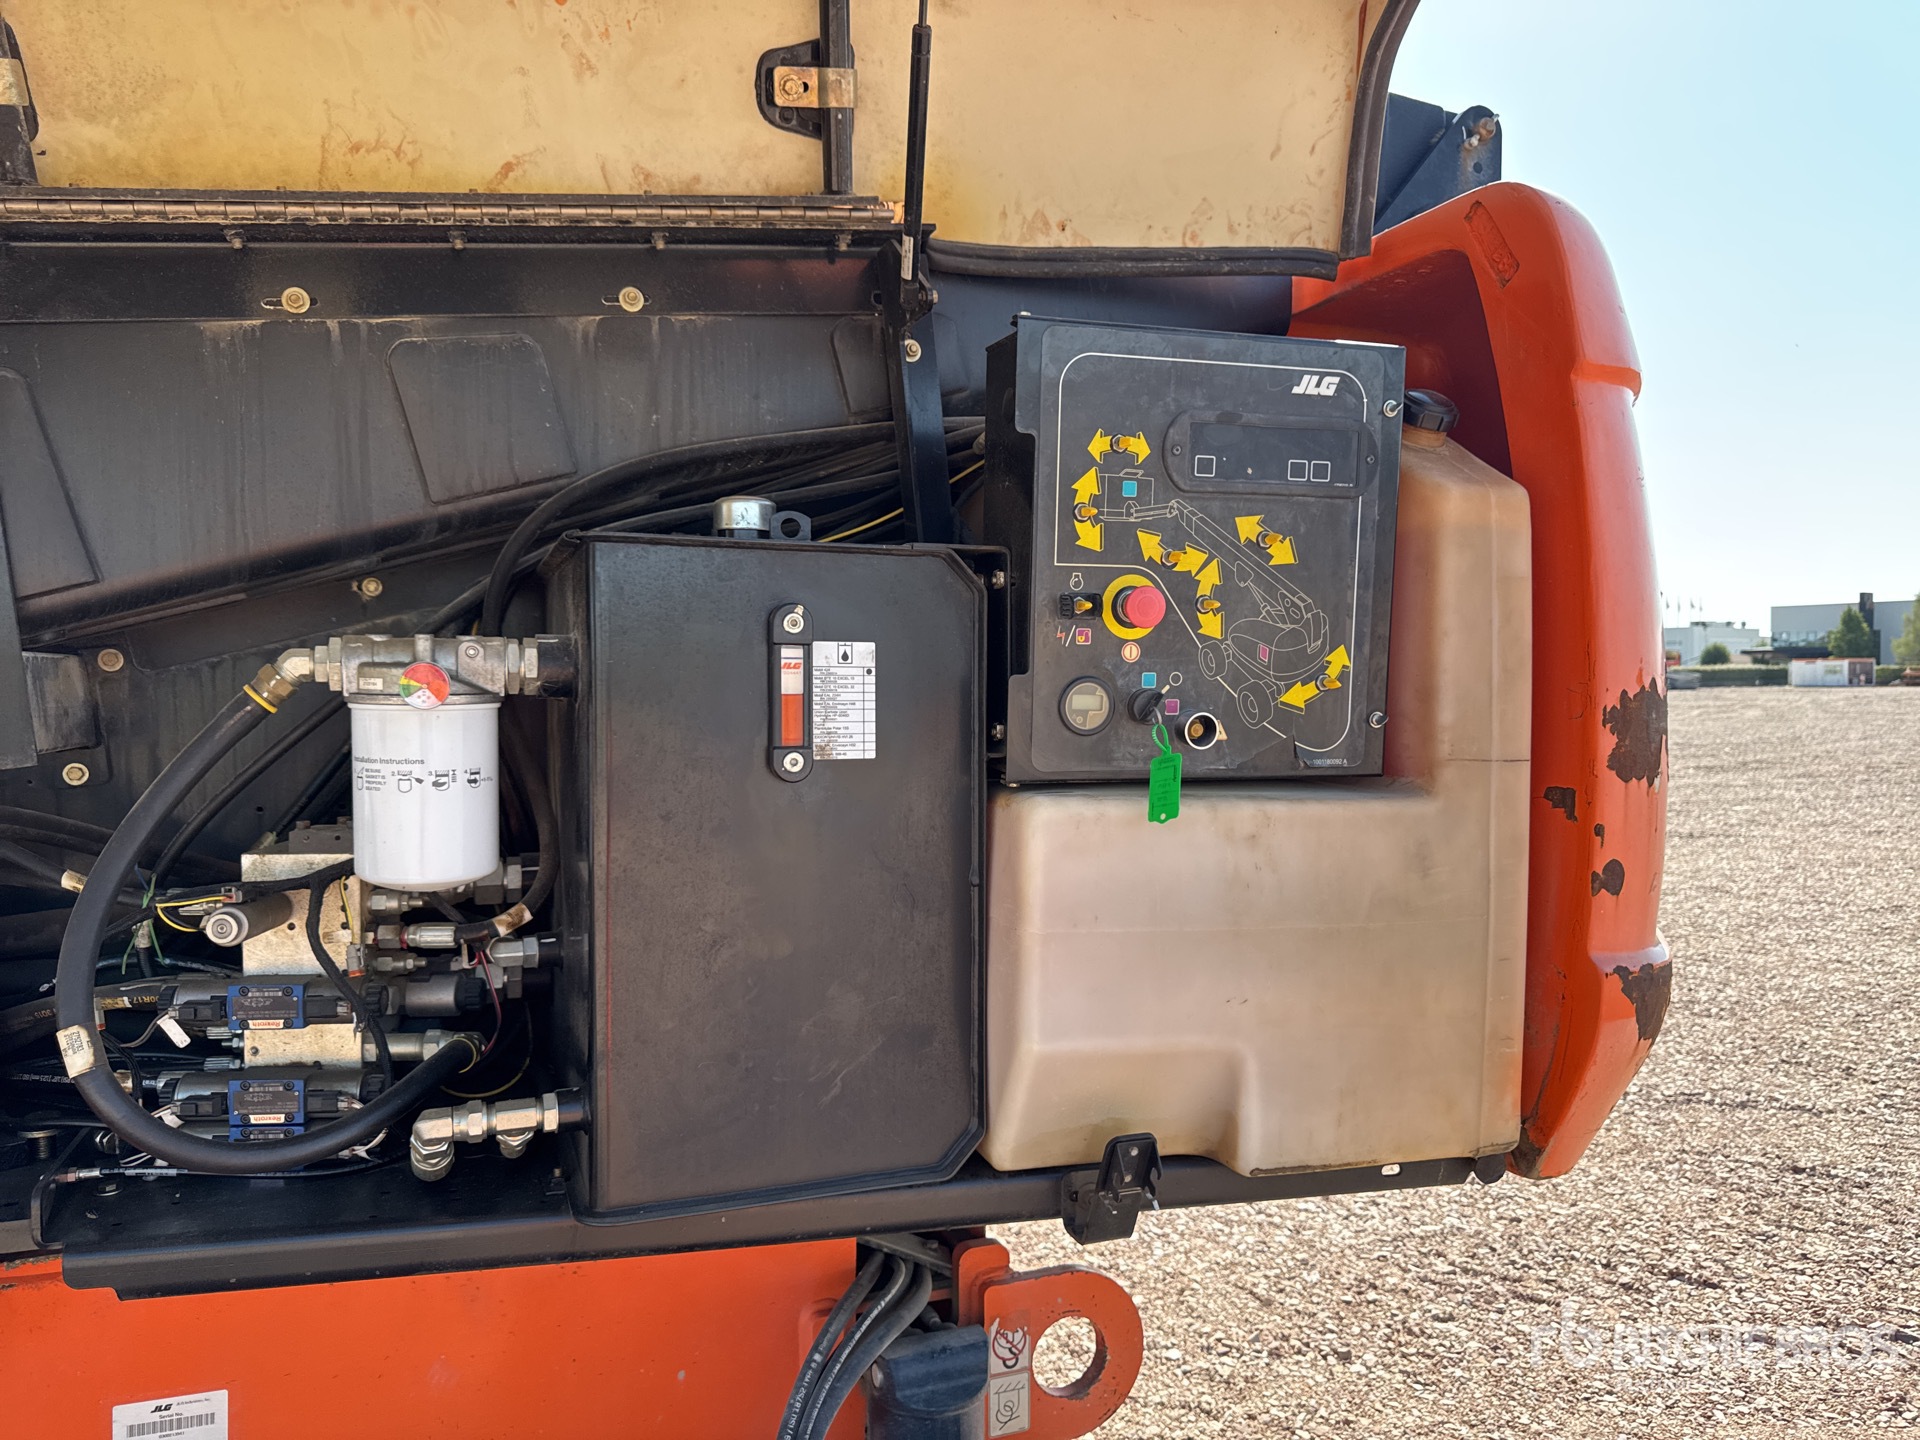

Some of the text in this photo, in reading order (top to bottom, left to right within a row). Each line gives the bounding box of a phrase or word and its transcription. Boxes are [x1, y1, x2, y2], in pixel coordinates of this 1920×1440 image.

[1291, 374, 1341, 397] JLG
[780, 662, 802, 670] JLG
[150, 1404, 173, 1413] JLG
